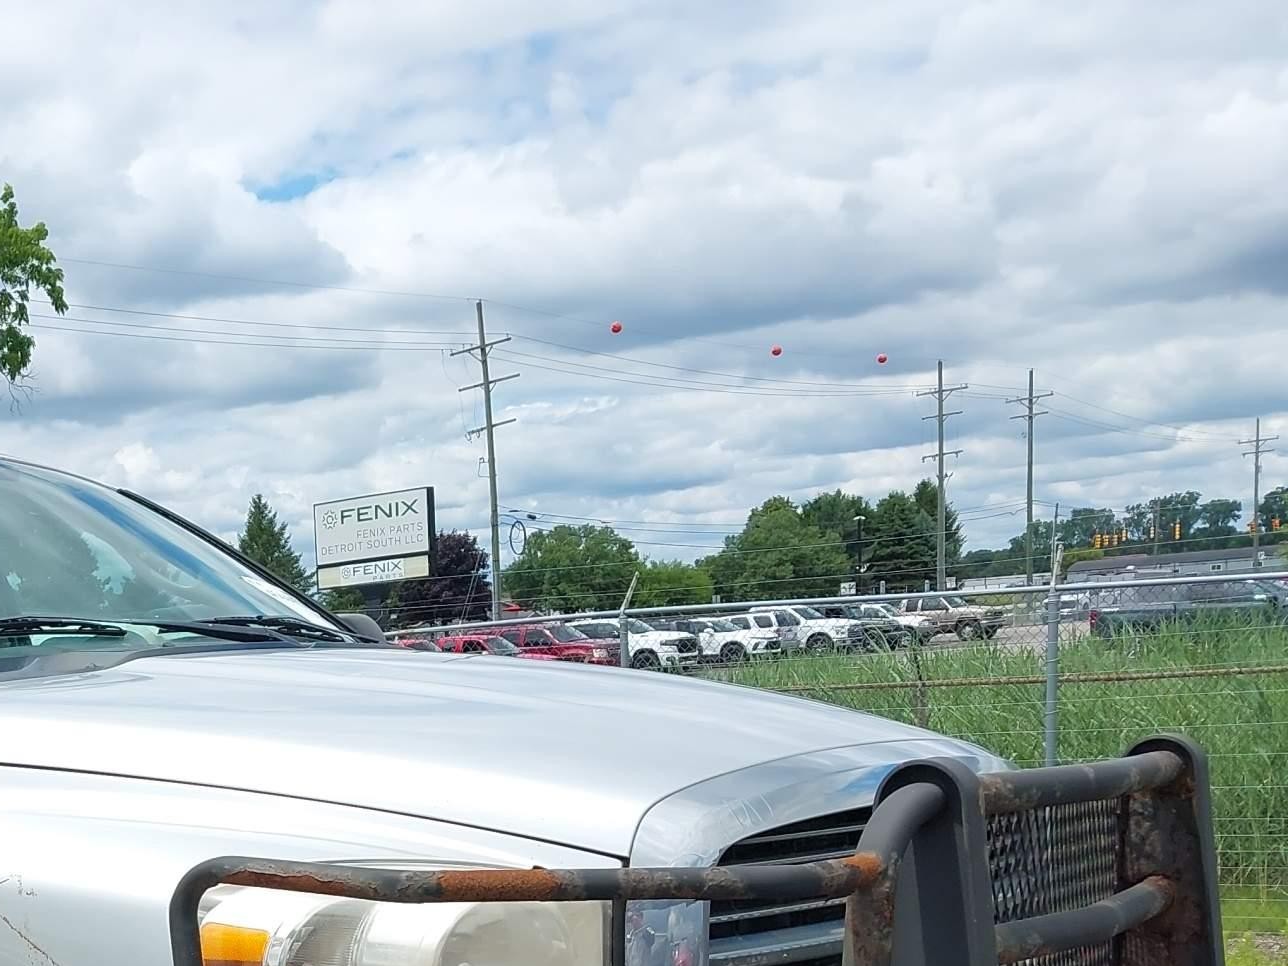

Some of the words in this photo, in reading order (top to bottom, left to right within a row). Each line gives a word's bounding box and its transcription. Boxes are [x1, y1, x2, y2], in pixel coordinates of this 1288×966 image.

[340, 498, 420, 525] FENIX
[356, 527, 386, 539] FENIX
[389, 521, 424, 535] PARTS
[321, 541, 363, 556] DETROIT
[366, 537, 401, 550] SOUTH
[404, 533, 424, 544] LLC
[352, 560, 402, 577] FENIX
